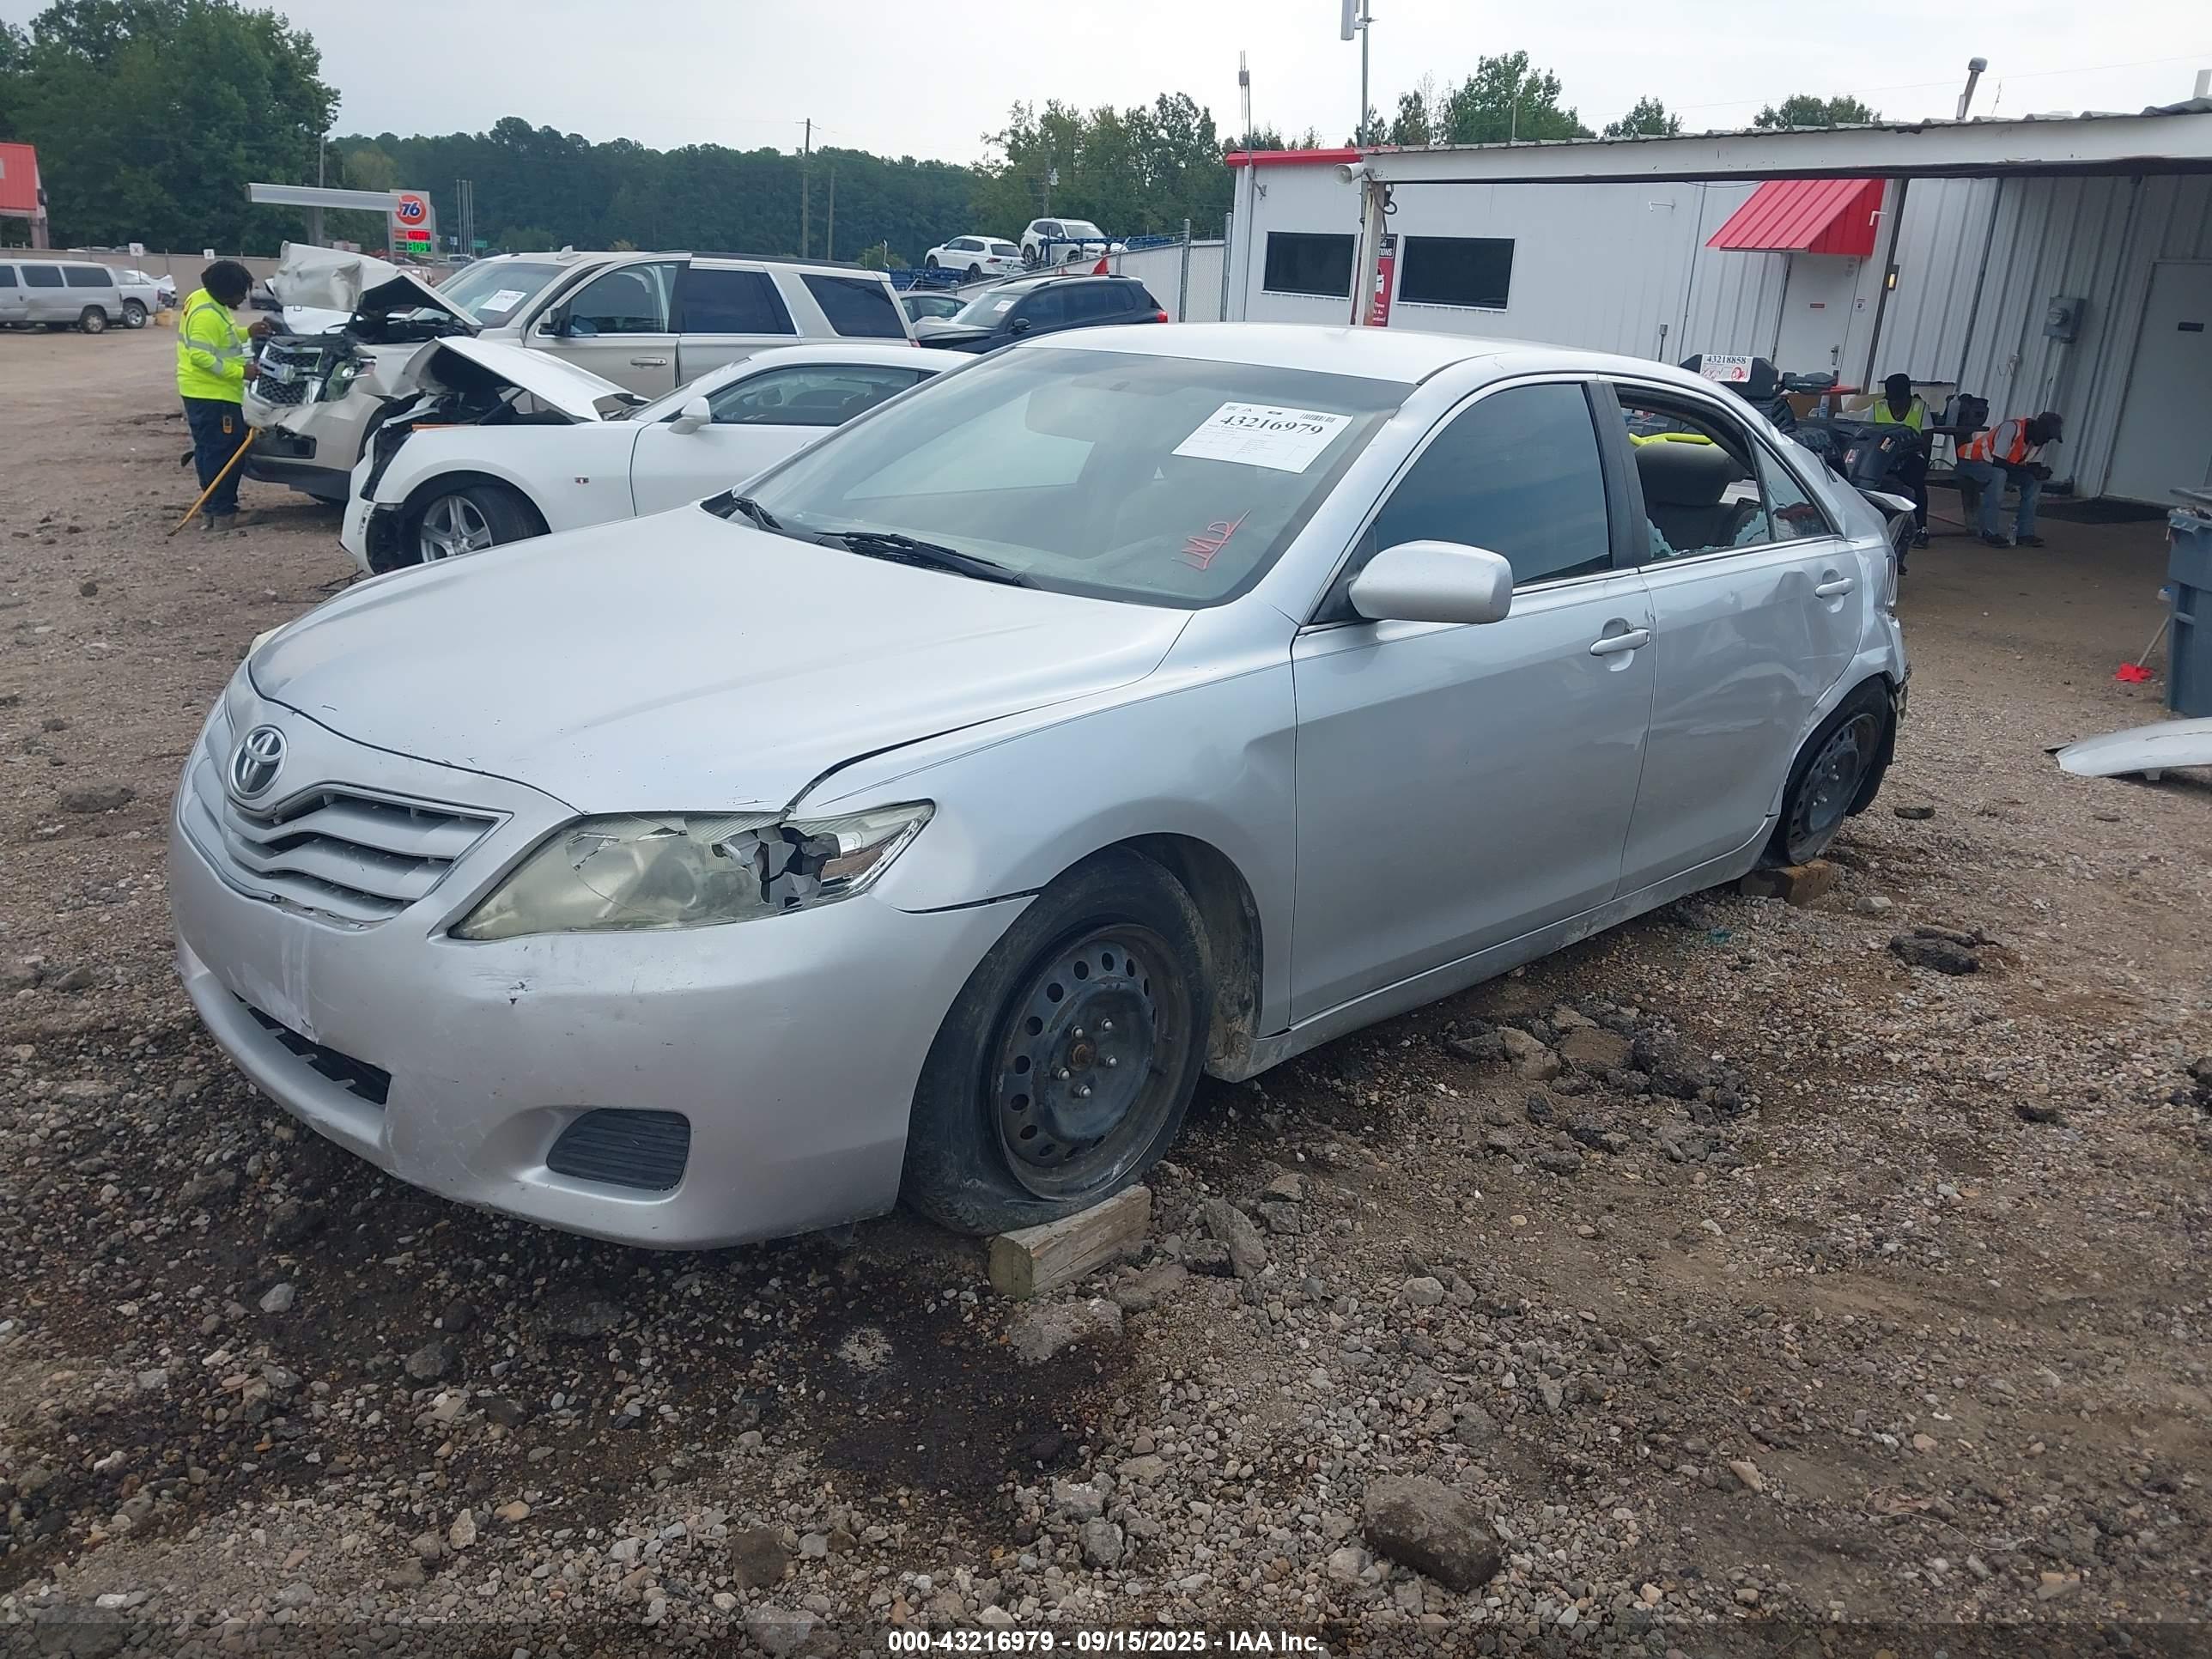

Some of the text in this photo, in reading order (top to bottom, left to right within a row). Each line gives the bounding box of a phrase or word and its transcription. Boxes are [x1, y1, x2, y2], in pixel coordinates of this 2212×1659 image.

[400, 202, 421, 217] 76
[1706, 355, 1747, 365] 43218858
[1219, 415, 1323, 435] 43216979
